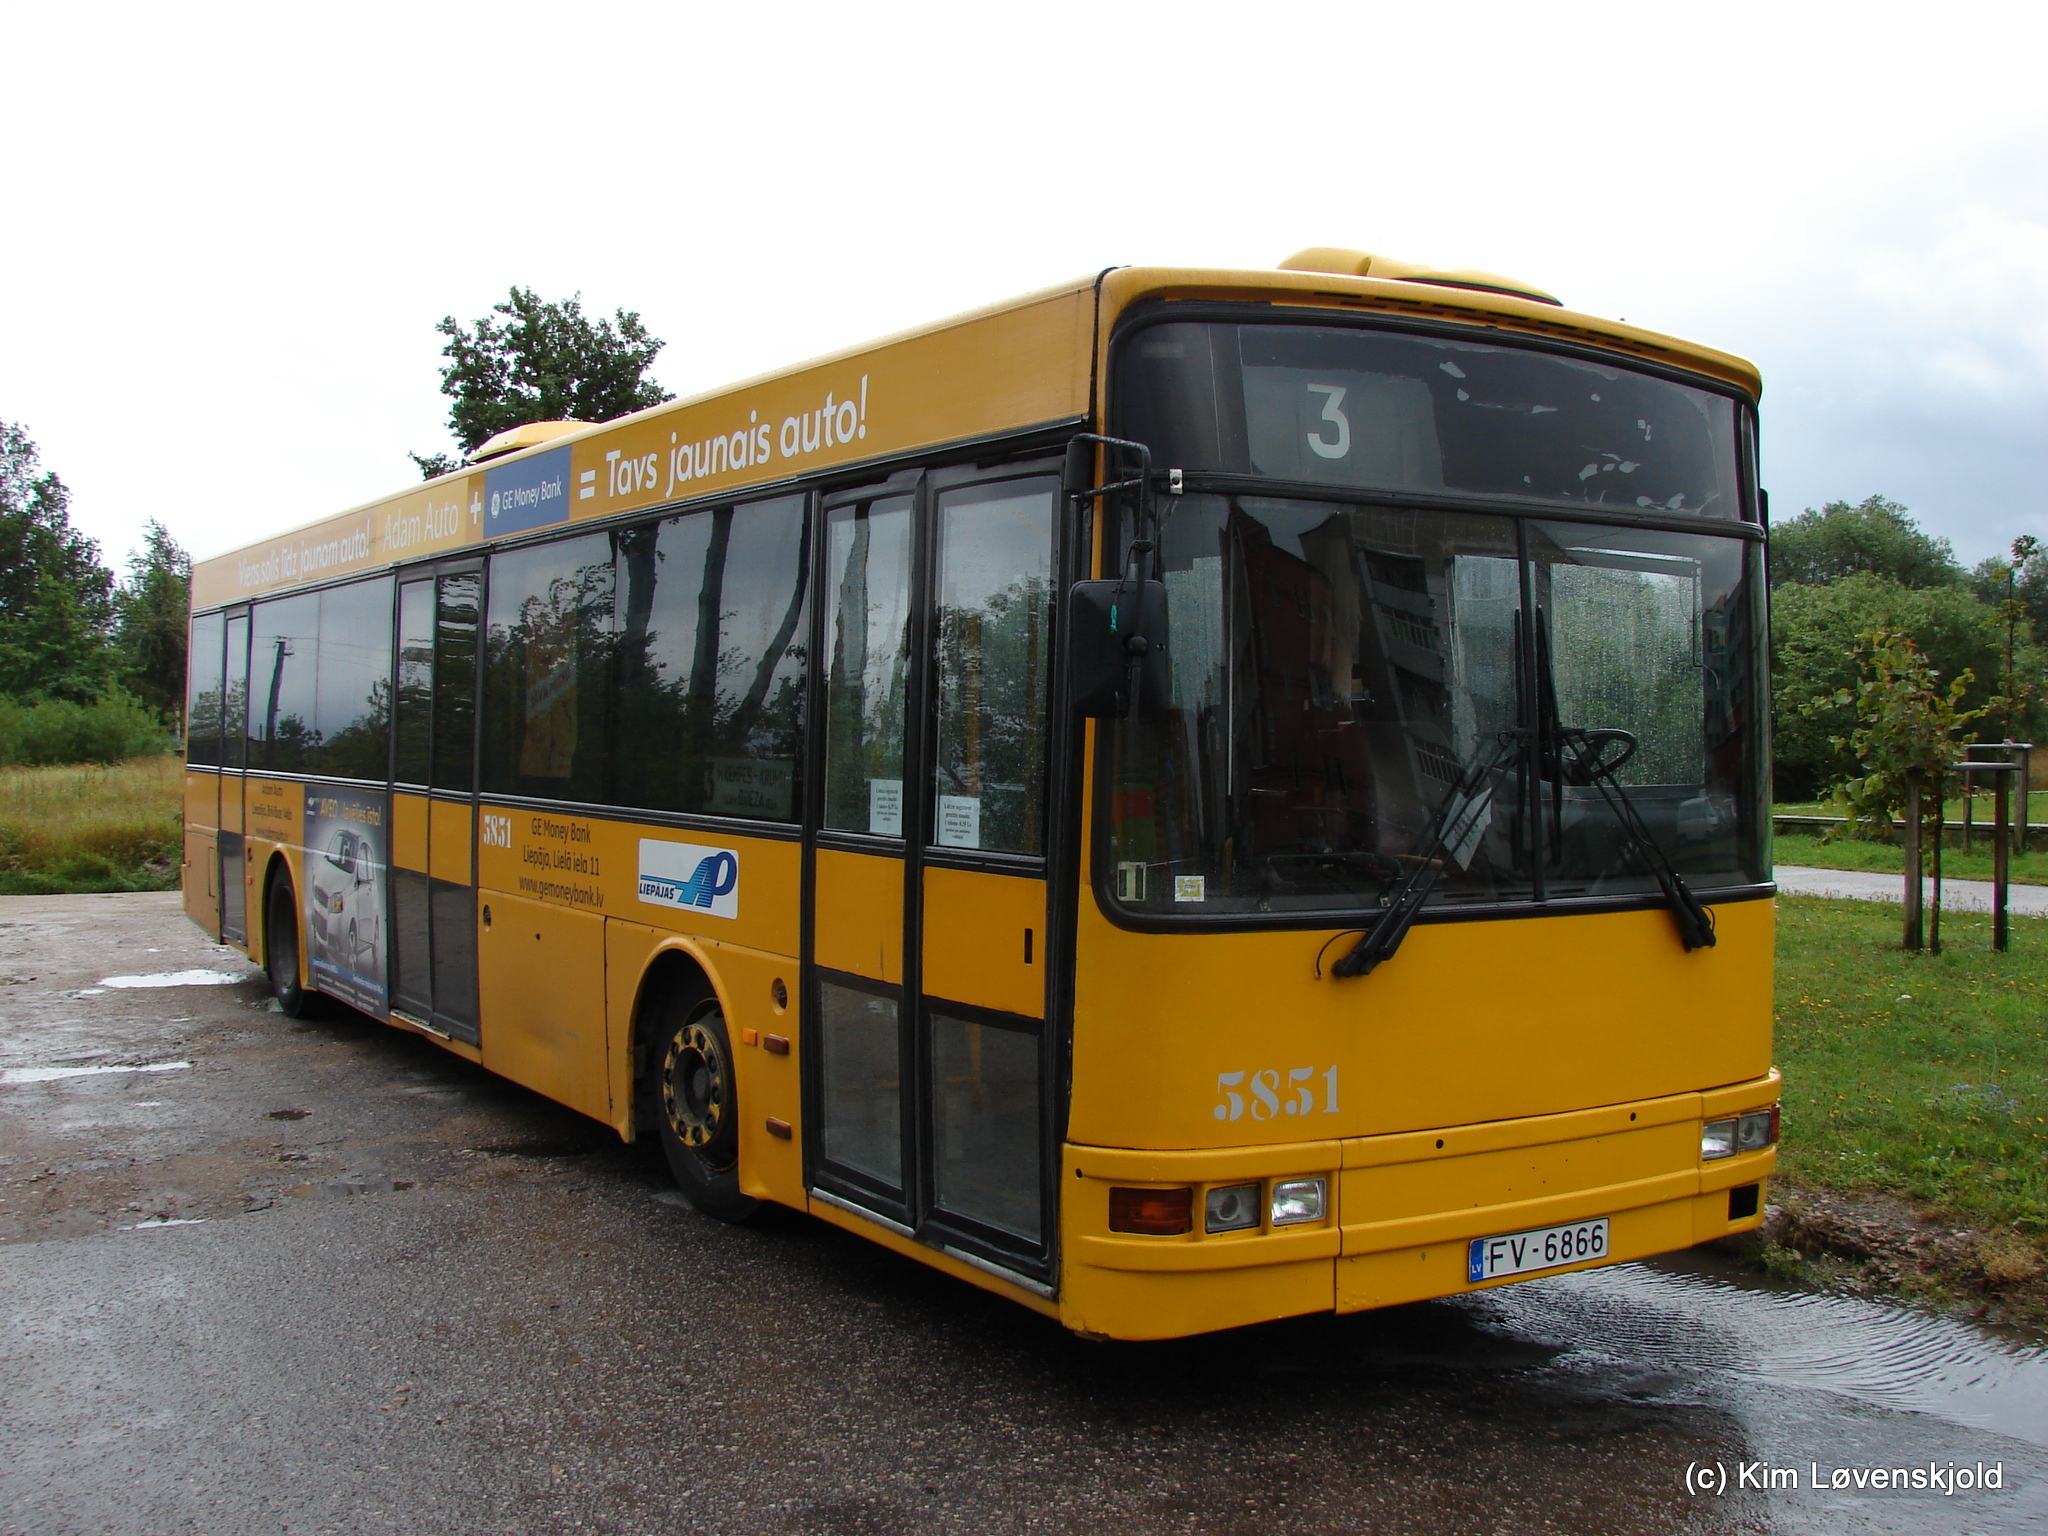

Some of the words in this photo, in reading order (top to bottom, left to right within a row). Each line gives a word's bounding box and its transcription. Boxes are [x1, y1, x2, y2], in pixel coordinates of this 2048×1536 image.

[1306, 383, 1350, 459] 3
[299, 539, 338, 582] jaunam
[340, 518, 370, 563] auto!
[383, 509, 420, 551] Adam
[423, 502, 459, 541] Auto
[502, 489, 513, 510] GE
[514, 487, 540, 509] Money
[541, 475, 562, 500] Bank
[606, 450, 657, 498] Tavs
[665, 410, 771, 498] jaunais
[779, 374, 869, 459] auto!
[483, 815, 512, 849] 5851
[531, 817, 542, 836] GE
[544, 819, 569, 844] Money
[571, 822, 591, 844] Bank
[573, 852, 588, 874] iela
[590, 856, 600, 876] 11
[519, 877, 604, 908] www.gemoneybank.lv
[1213, 1064, 1340, 1122] 5851
[1471, 1263, 1482, 1273] LV
[1490, 1224, 1603, 1272] FV-6866
